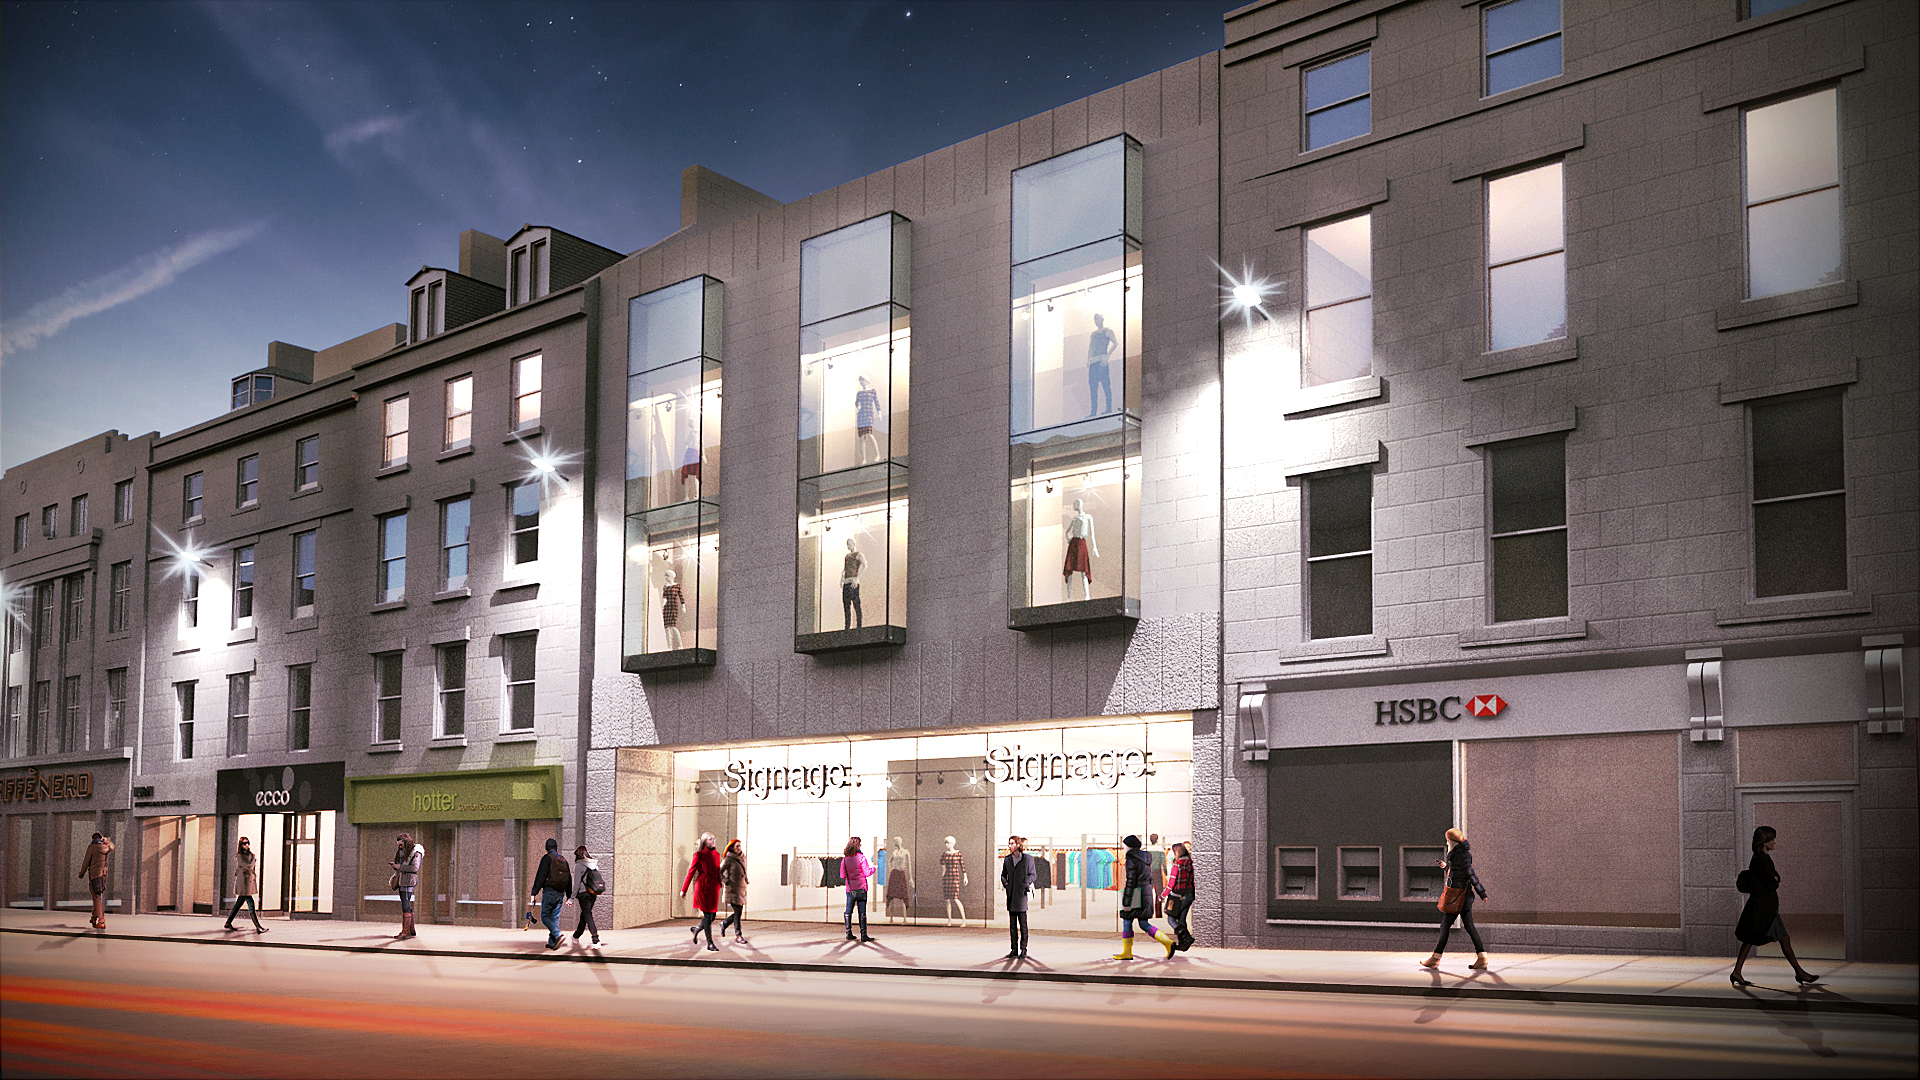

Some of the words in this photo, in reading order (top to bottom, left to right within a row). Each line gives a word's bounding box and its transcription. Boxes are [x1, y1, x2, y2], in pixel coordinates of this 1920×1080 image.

[1374, 696, 1461, 725] HSBC
[724, 759, 849, 800] Signage
[985, 744, 1144, 791] Signage
[0, 767, 38, 801] FFÈ
[39, 772, 92, 799] NERO
[255, 790, 290, 806] ecco
[413, 790, 457, 811] hotter
